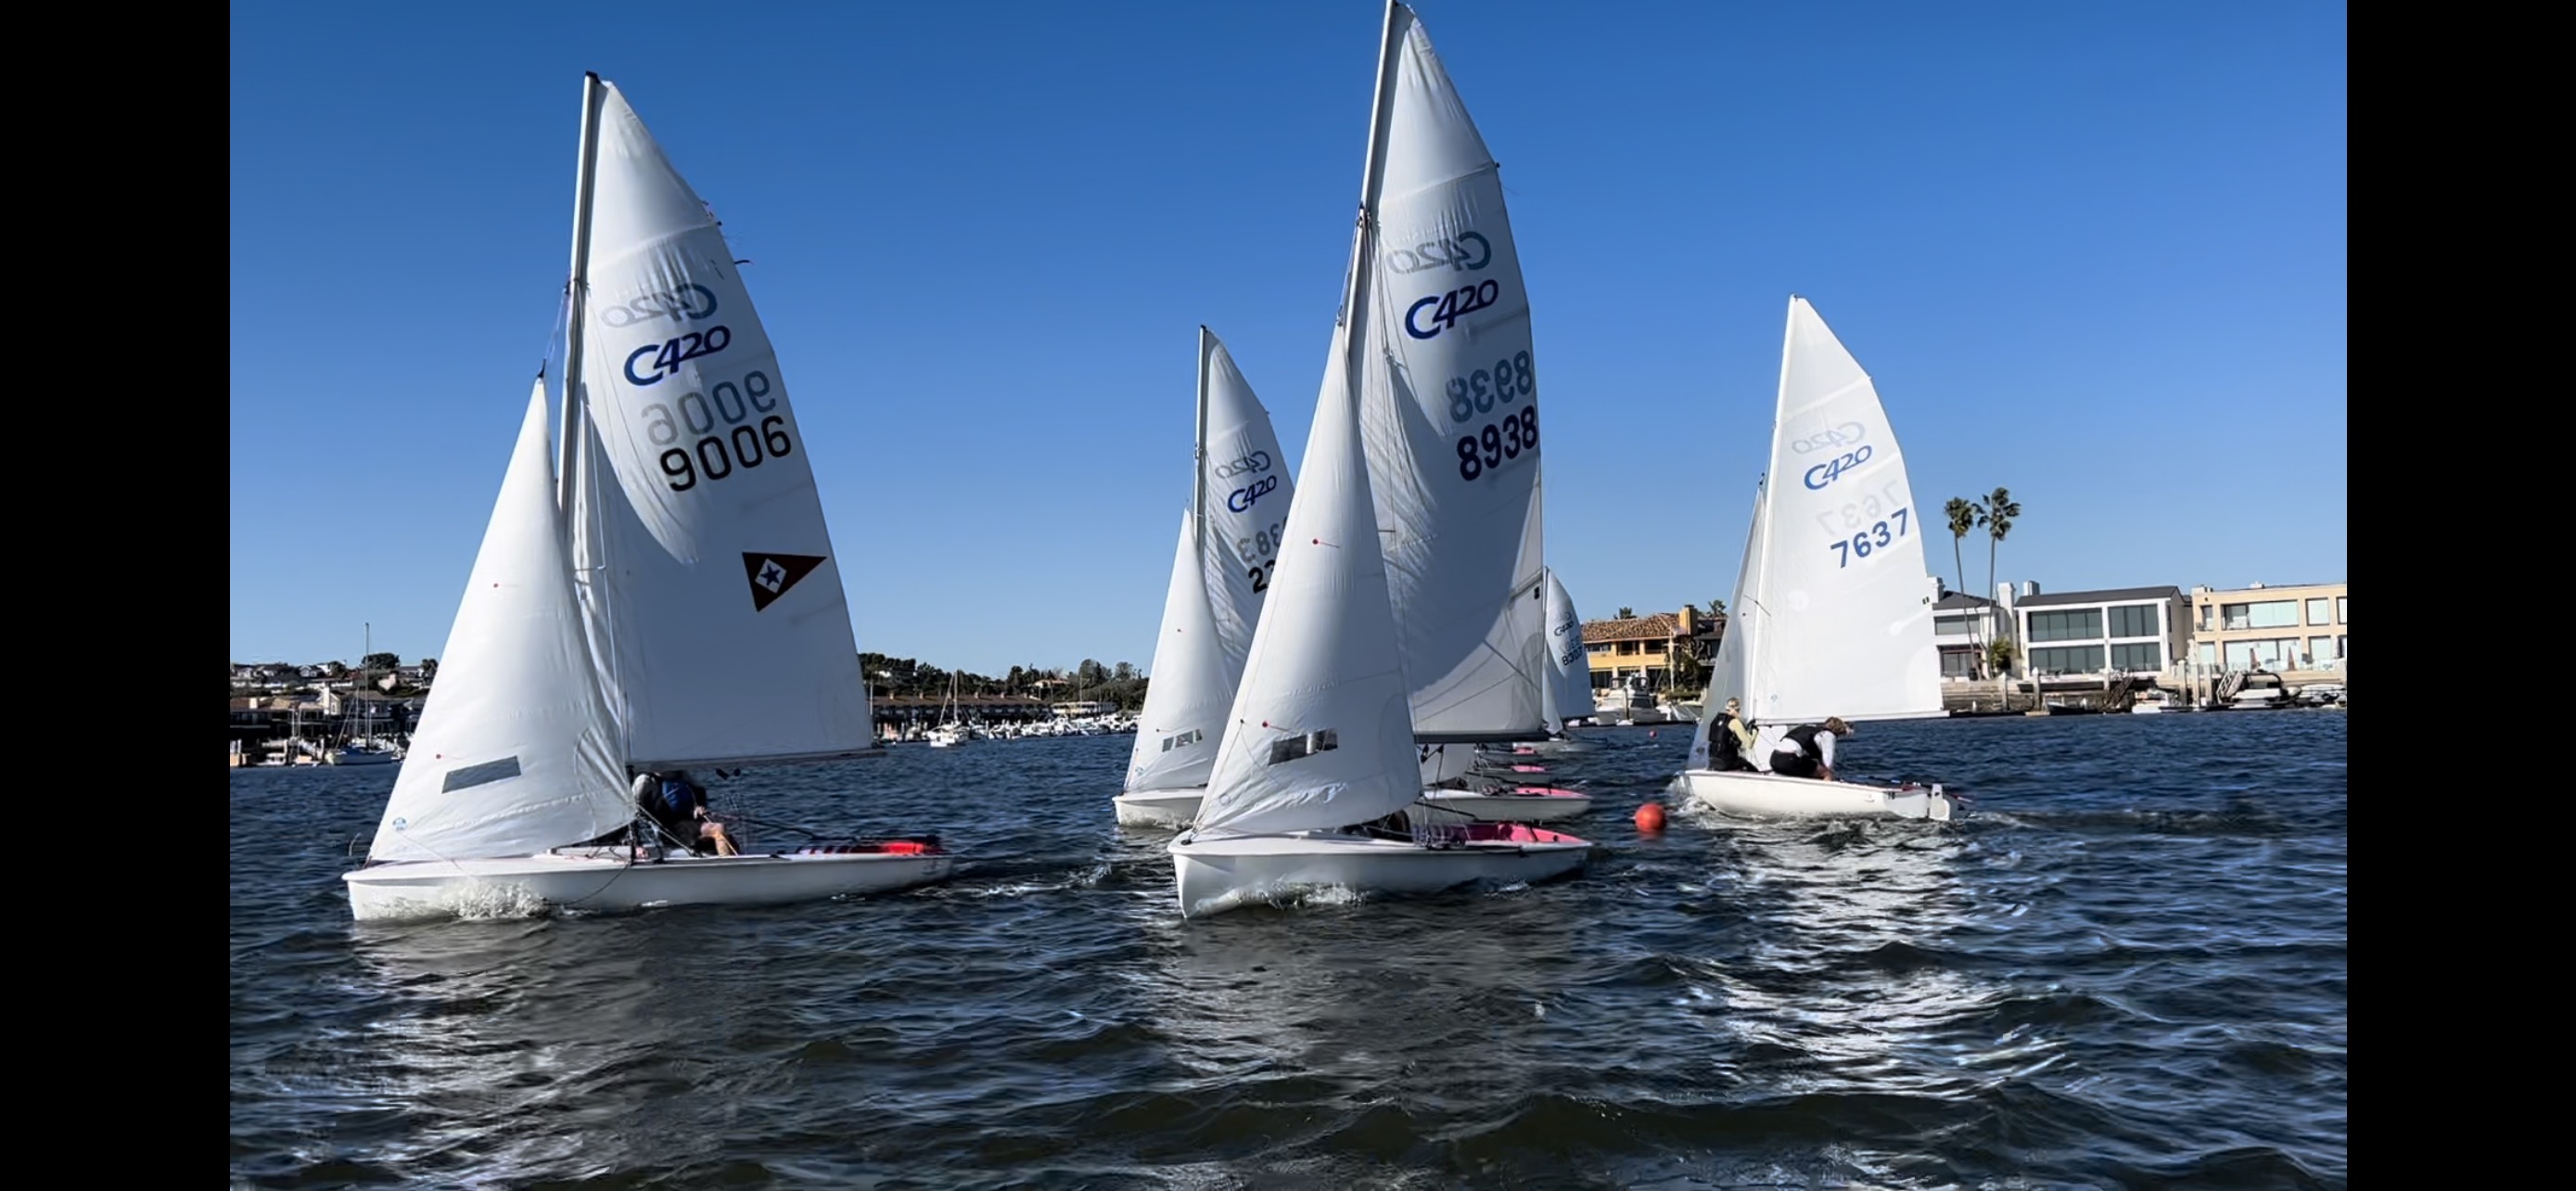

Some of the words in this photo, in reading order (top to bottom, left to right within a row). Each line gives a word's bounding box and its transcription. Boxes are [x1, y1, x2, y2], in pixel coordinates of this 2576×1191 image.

[1405, 278, 1499, 339] C420
[623, 325, 732, 387] C420
[659, 415, 792, 493] 9006
[1456, 404, 1538, 481] 8938
[1804, 444, 1872, 491] C420
[1227, 475, 1278, 513] C420
[1830, 507, 1908, 569] 7637
